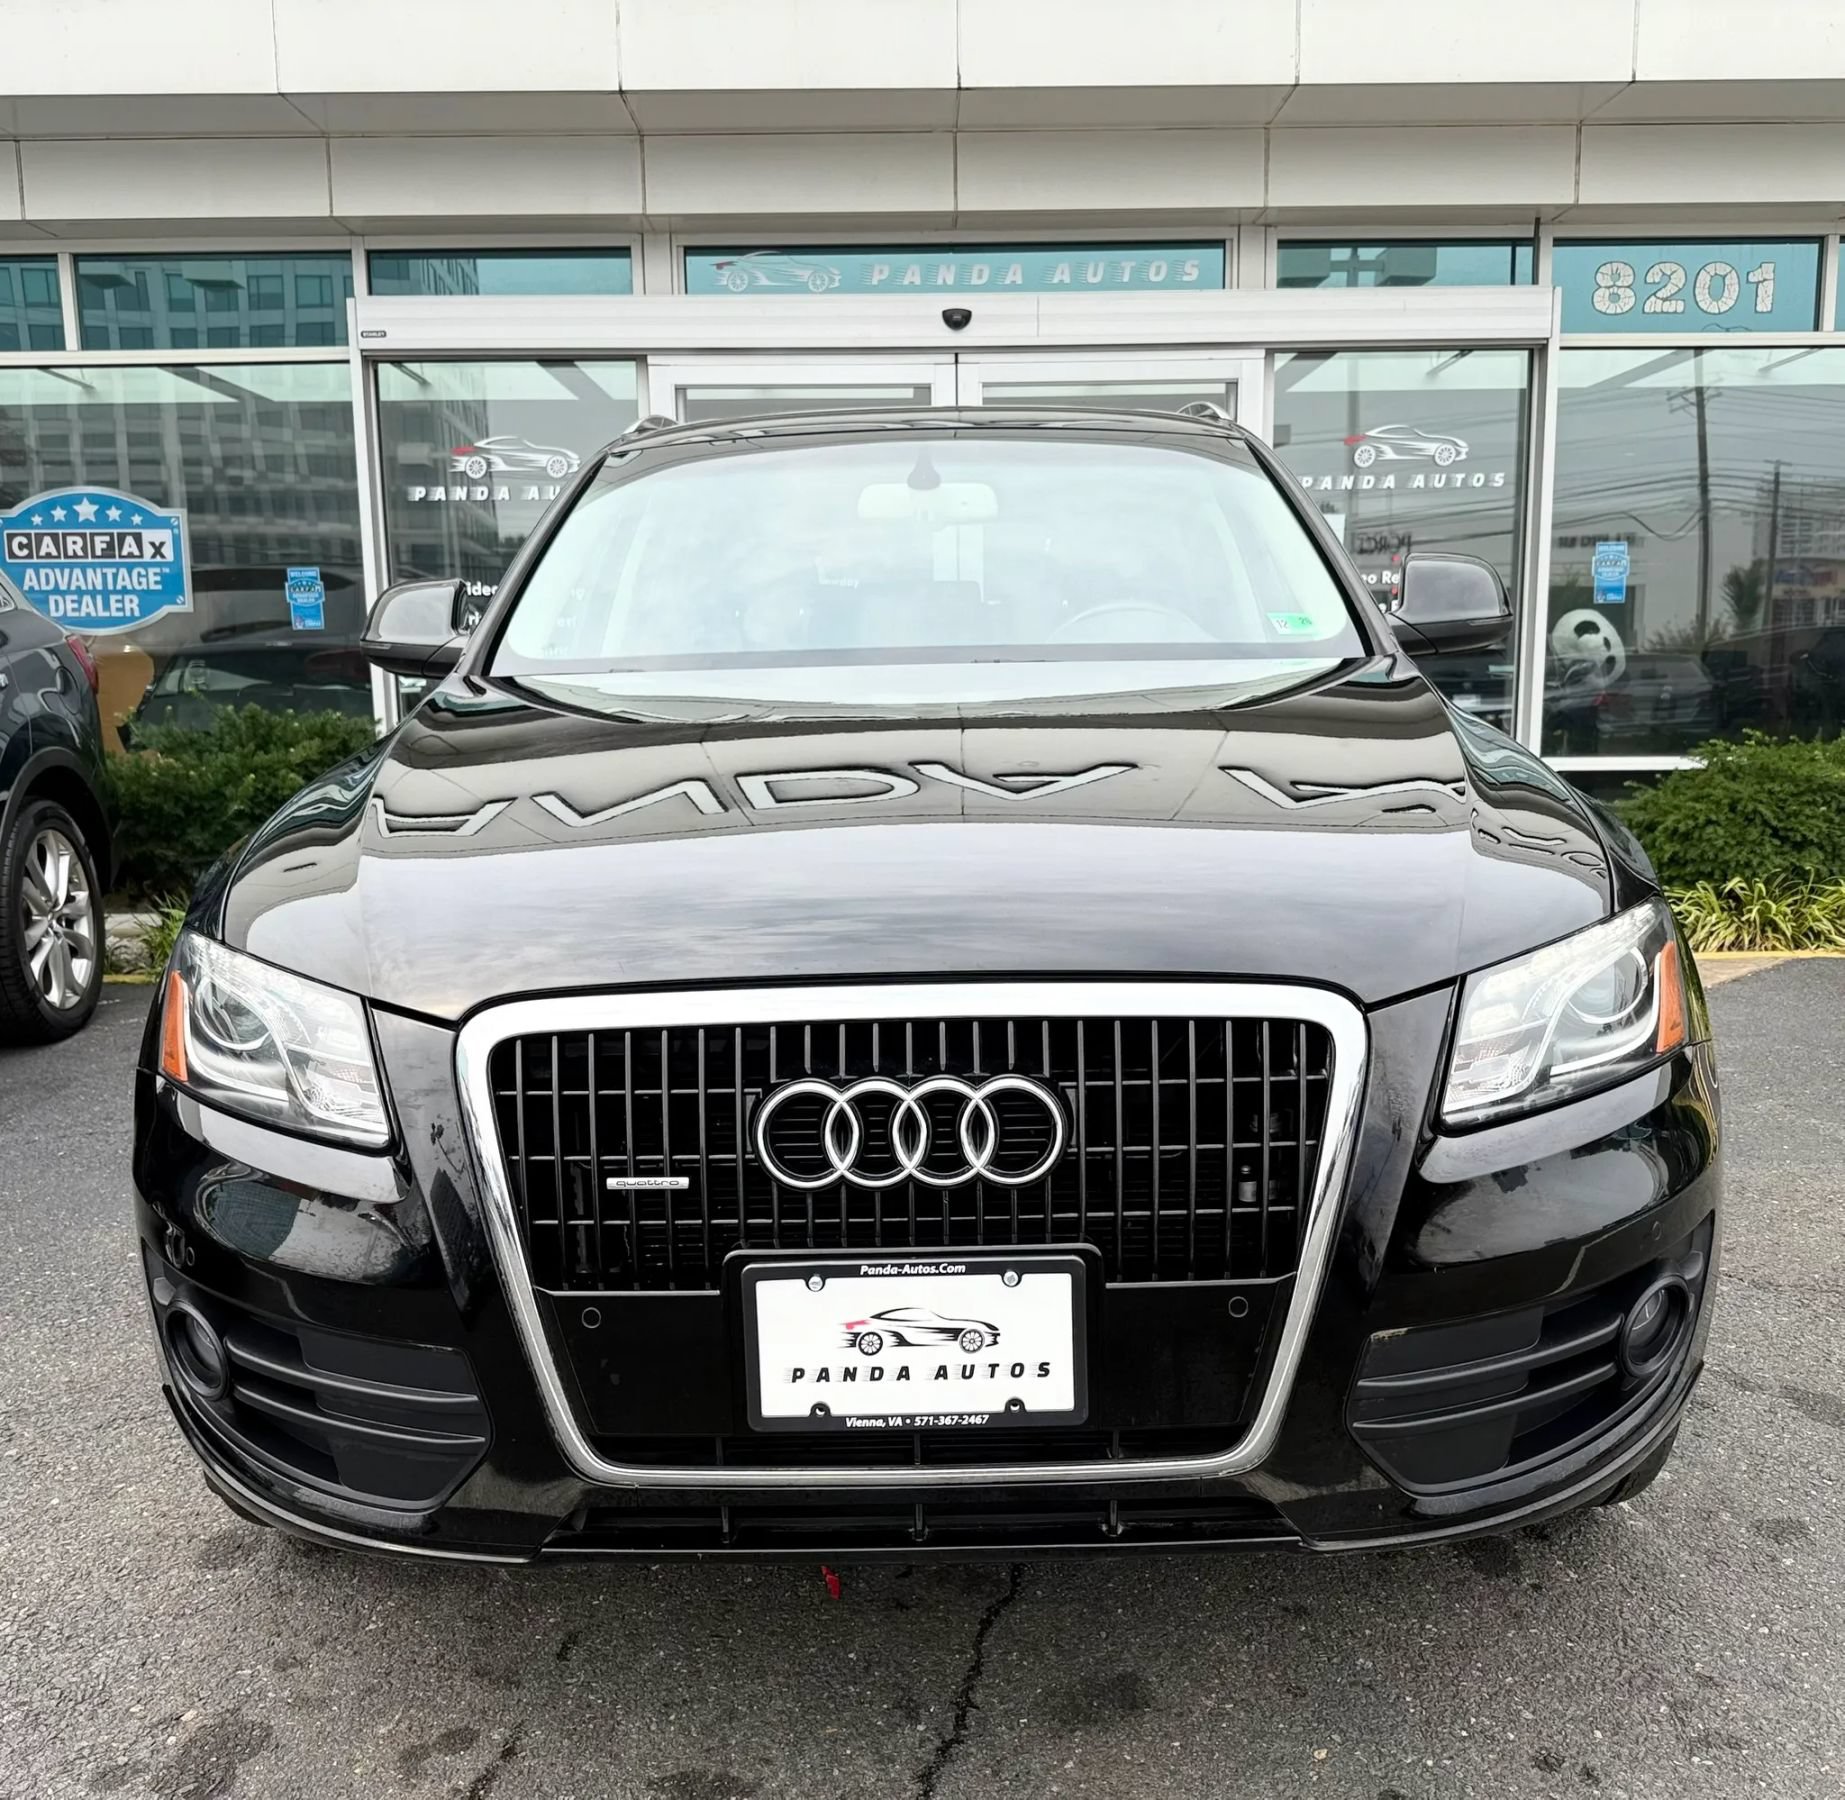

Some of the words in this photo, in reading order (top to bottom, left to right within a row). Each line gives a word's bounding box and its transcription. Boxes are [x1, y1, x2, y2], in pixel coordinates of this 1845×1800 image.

[868, 263, 1024, 286] PANDA
[1047, 260, 1201, 284] AUTOS
[1592, 261, 1777, 315] 8201
[1301, 474, 1396, 490] PANDA
[1410, 472, 1505, 489] AUTOS
[410, 485, 511, 501] PANDA
[524, 485, 561, 501] AU
[11, 535, 168, 560] CARFAX
[48, 594, 141, 617] DEALER
[615, 1180, 680, 1188] quattro
[860, 1263, 967, 1276] Panda-Autos.Com
[789, 1365, 912, 1384] PANDA
[932, 1361, 1051, 1381] AUTOS
[845, 1416, 886, 1428] Vienna,
[887, 1416, 903, 1427] VA
[913, 1414, 990, 1426] 571-367-2467
